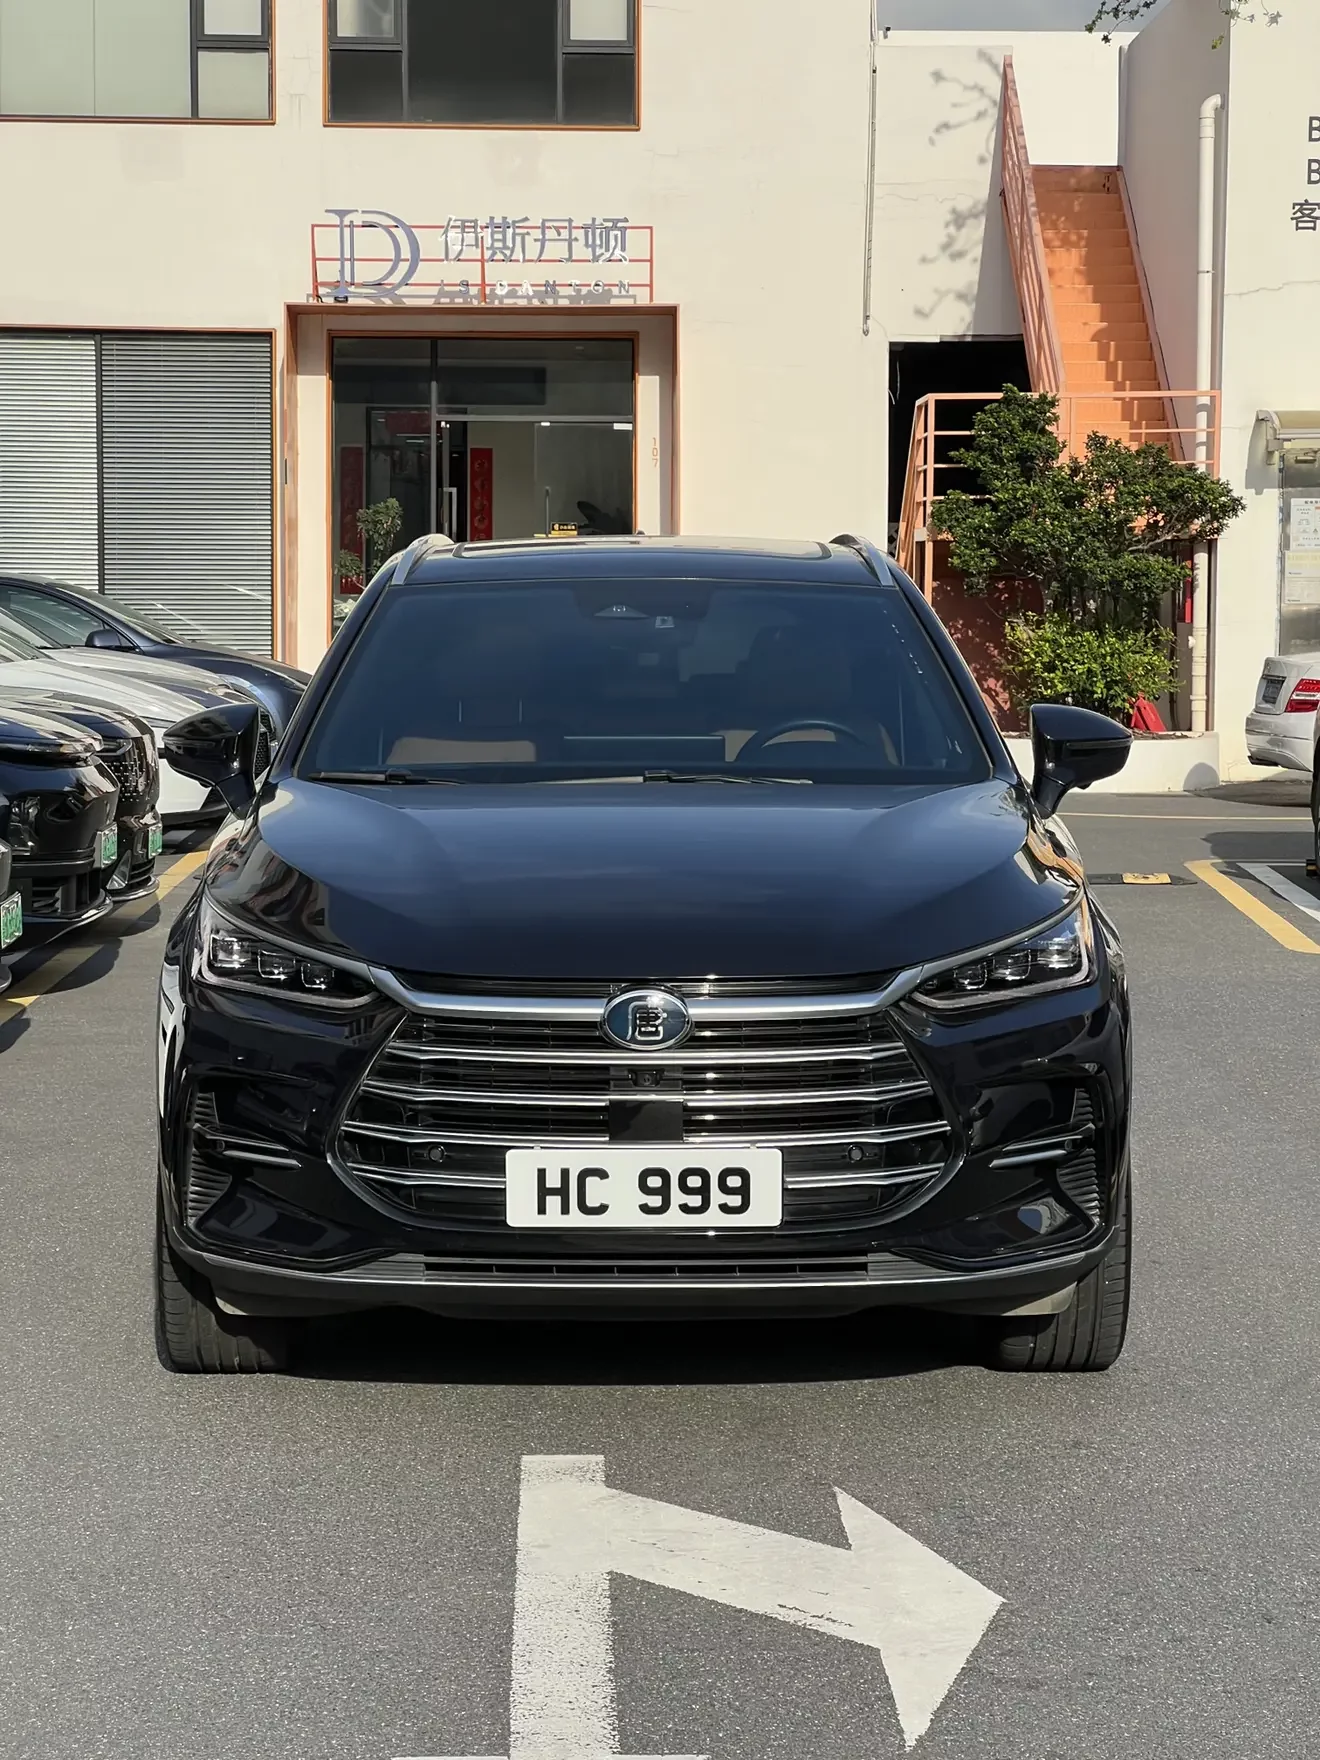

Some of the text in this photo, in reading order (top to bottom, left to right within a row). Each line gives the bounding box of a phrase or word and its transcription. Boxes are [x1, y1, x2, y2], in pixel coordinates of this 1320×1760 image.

[438, 215, 630, 265] 伊斯丹顿
[651, 436, 659, 468] 107
[536, 1166, 751, 1216] HC 999
